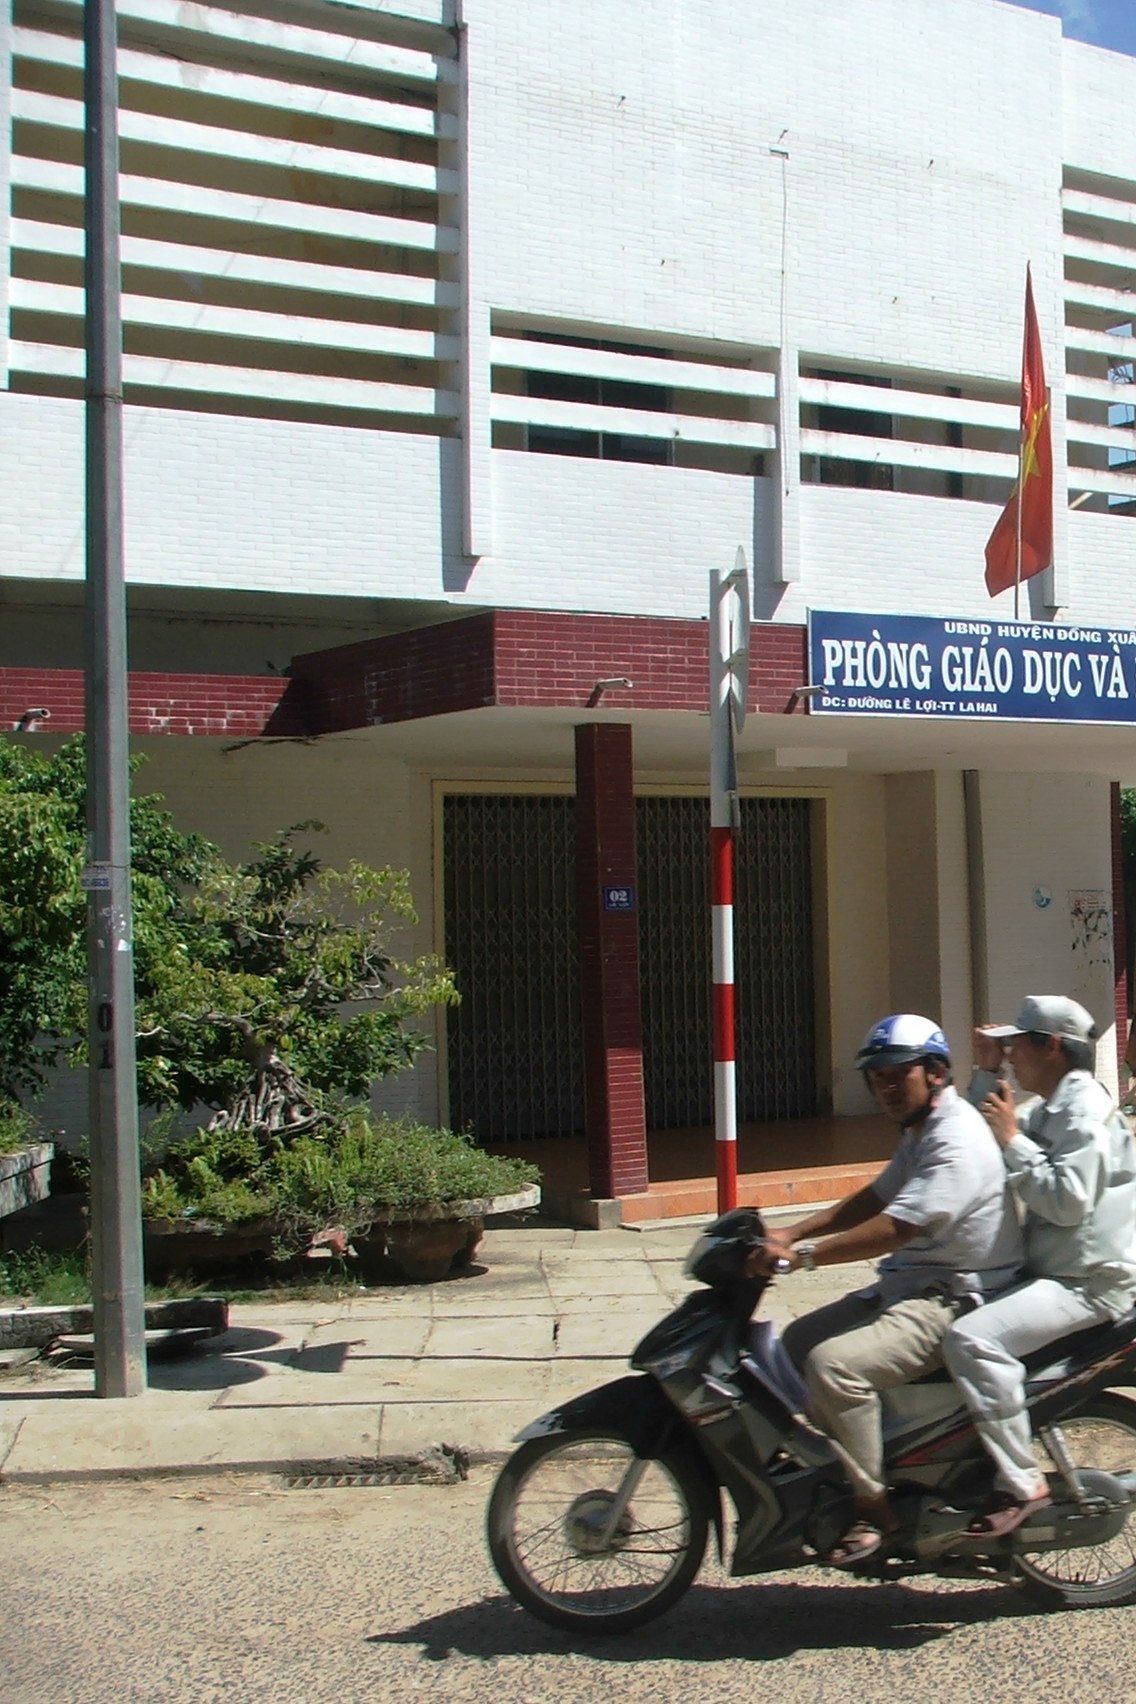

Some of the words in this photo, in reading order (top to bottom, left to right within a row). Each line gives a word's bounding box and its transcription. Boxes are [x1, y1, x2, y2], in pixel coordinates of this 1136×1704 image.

[944, 621, 992, 636] UBND
[998, 624, 1054, 641] HUYỆN
[821, 629, 932, 690] PHÒNG
[941, 636, 1014, 694] GIÁO
[1023, 649, 1082, 703] DỤC
[1088, 644, 1129, 699] VÀ
[895, 696, 911, 710] LÊ
[609, 889, 628, 902] 02
